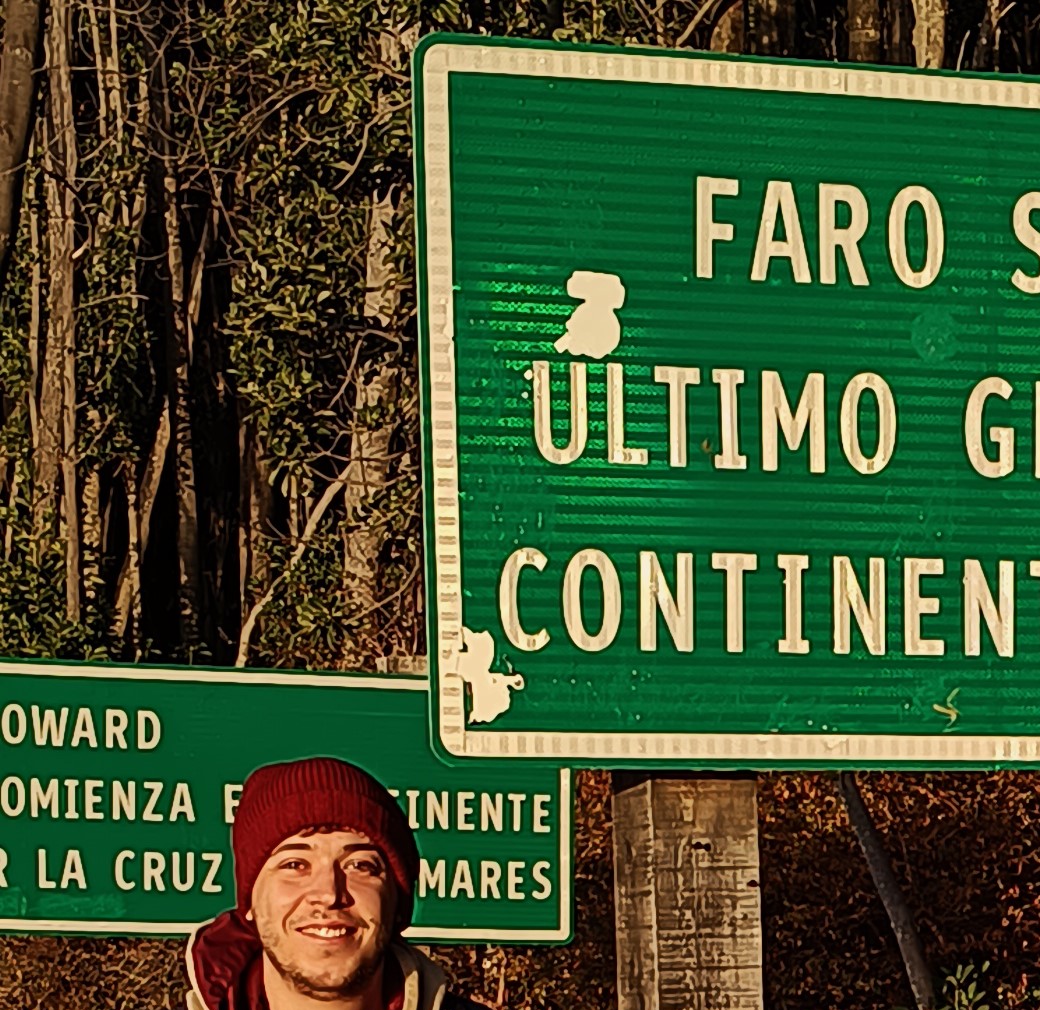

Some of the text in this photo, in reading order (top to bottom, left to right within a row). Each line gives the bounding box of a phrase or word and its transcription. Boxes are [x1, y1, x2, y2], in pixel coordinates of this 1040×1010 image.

[696, 175, 946, 289] FARO
[1, 703, 162, 750] OWARD
[0, 775, 196, 823] OMIENZA
[387, 789, 551, 833] INENTE
[38, 848, 88, 889] LA
[114, 849, 223, 893] CRUZ
[418, 858, 552, 900] MARES
